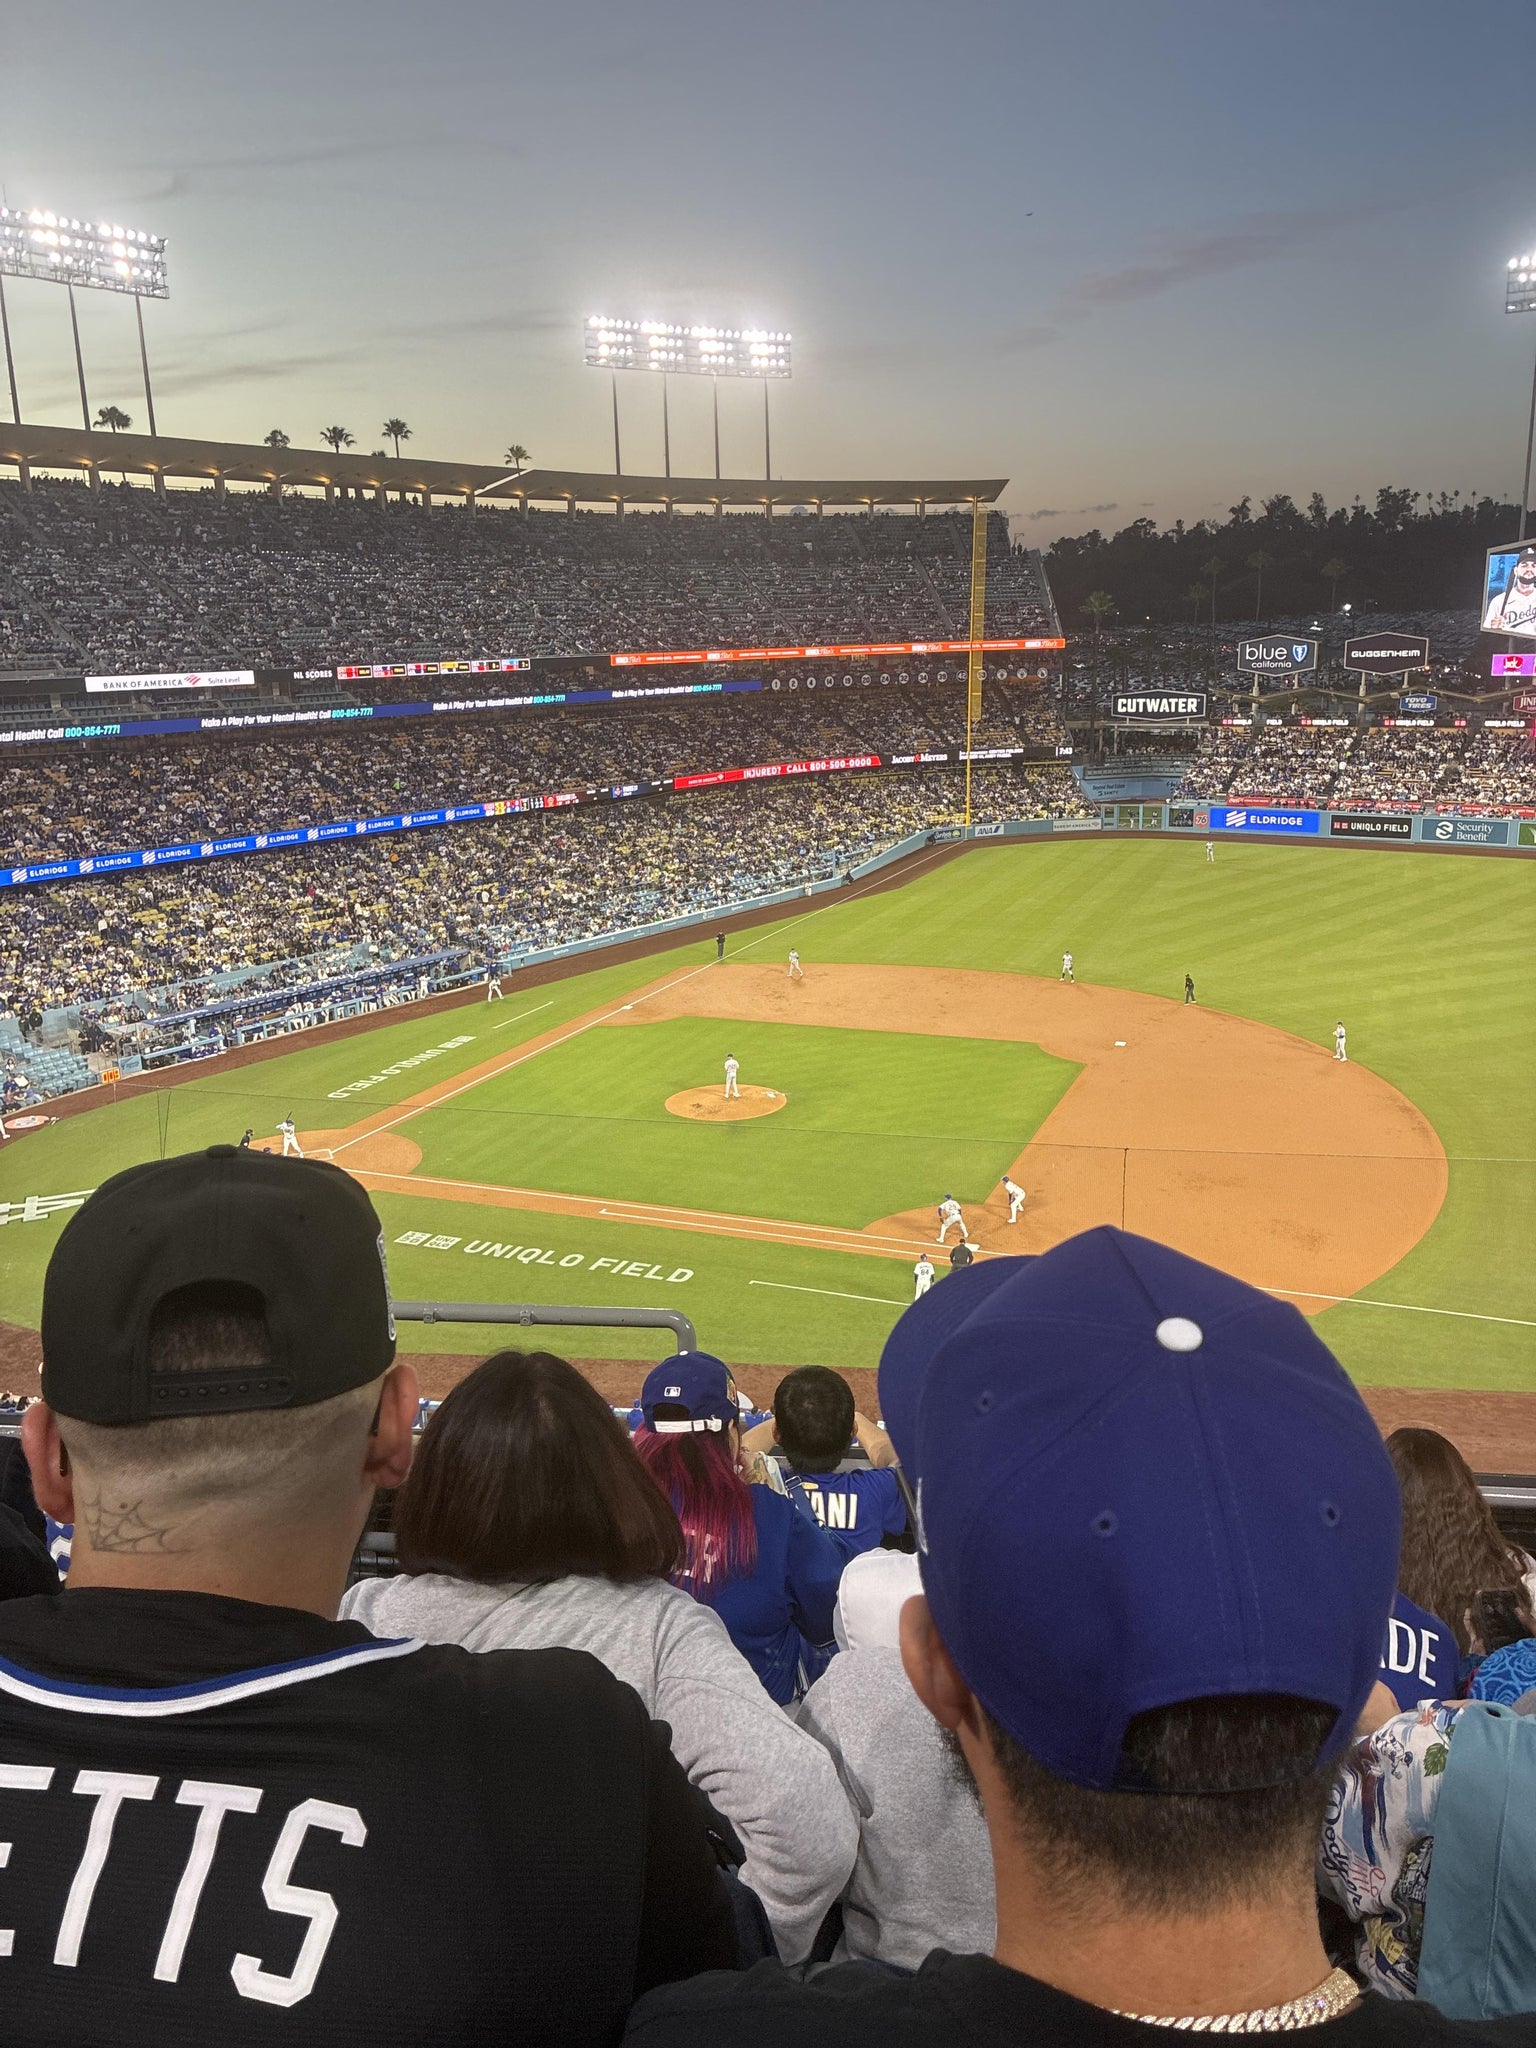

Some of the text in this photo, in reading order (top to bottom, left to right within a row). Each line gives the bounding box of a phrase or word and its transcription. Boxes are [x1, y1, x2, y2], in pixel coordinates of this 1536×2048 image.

[1246, 644, 1288, 660] blue
[1351, 650, 1420, 658] GUGGENHEIM
[1251, 661, 1292, 669] california
[225, 676, 241, 684] Level
[293, 671, 304, 679] NL
[305, 670, 333, 679] SCORES
[144, 679, 183, 687] AMERICA
[1117, 698, 1197, 713] CUTWATER
[201, 717, 221, 728] Make
[221, 717, 227, 726] A
[227, 716, 244, 727] Play
[244, 715, 256, 725] For
[256, 714, 272, 724] Your
[272, 712, 295, 723] Mental
[319, 710, 332, 720] Call
[332, 707, 373, 718] 800-854-7771
[0, 725, 120, 742] tal Health! Call 800-854-7771
[743, 758, 872, 779] INJURED? CALL 800-500-0000
[456, 808, 480, 817] ELDRIDGE
[413, 814, 438, 823] ELDRIDGE
[1196, 815, 1207, 824] 76
[1250, 815, 1303, 826] ELDRIDGE
[367, 820, 394, 830] ELDRIDGE
[1351, 822, 1409, 833] UNIQLO FIELD
[1457, 822, 1493, 834] Security
[320, 826, 348, 836] ELDRIDGE
[977, 827, 993, 835] ANA
[1456, 831, 1488, 842] Benefit
[269, 833, 299, 844] ELDRIDGE
[215, 840, 247, 851] ELDRIDGE
[157, 848, 191, 860] ELDRIDGE
[96, 856, 132, 868] ELDRIDGE
[29, 866, 68, 878] ELDRIDGE
[327, 1048, 447, 1099] UNIQLO FIELD
[463, 1239, 695, 1283] UNIQLO FIELD
[805, 1491, 858, 1530] ANI
[1378, 1617, 1440, 1687] DE
